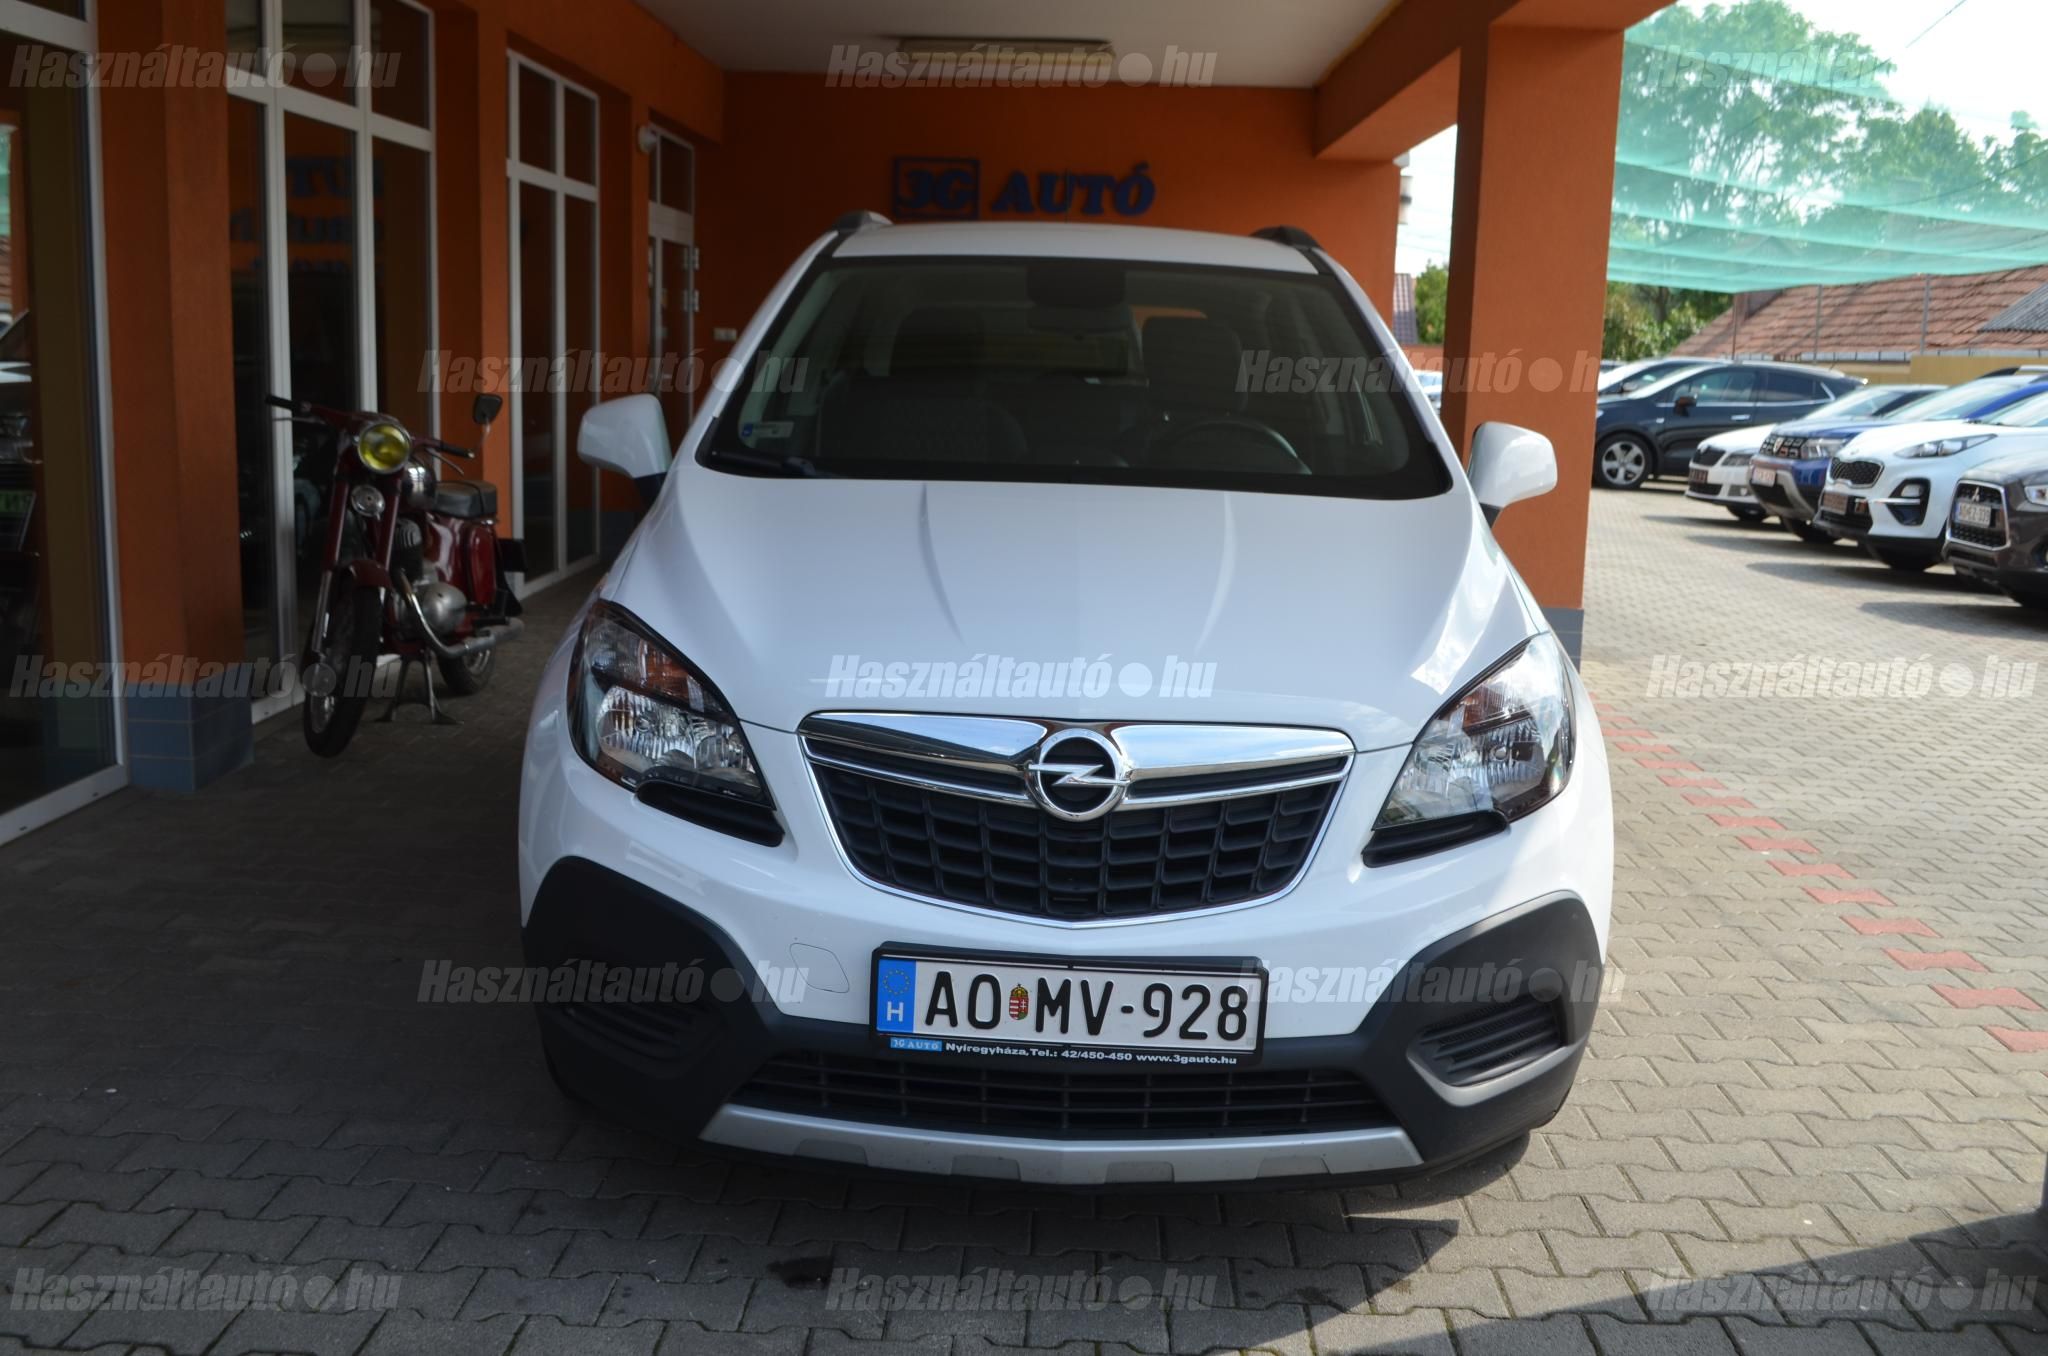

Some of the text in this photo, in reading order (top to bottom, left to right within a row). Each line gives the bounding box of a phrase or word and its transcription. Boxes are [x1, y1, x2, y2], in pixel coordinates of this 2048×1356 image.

[992, 160, 1156, 216] AUTÓ
[886, 1002, 904, 1022] H
[925, 971, 1249, 1041] AO MV-928
[1061, 1050, 1133, 1061] 42/450-450
[1136, 1054, 1237, 1065] www.3gauto.hu
